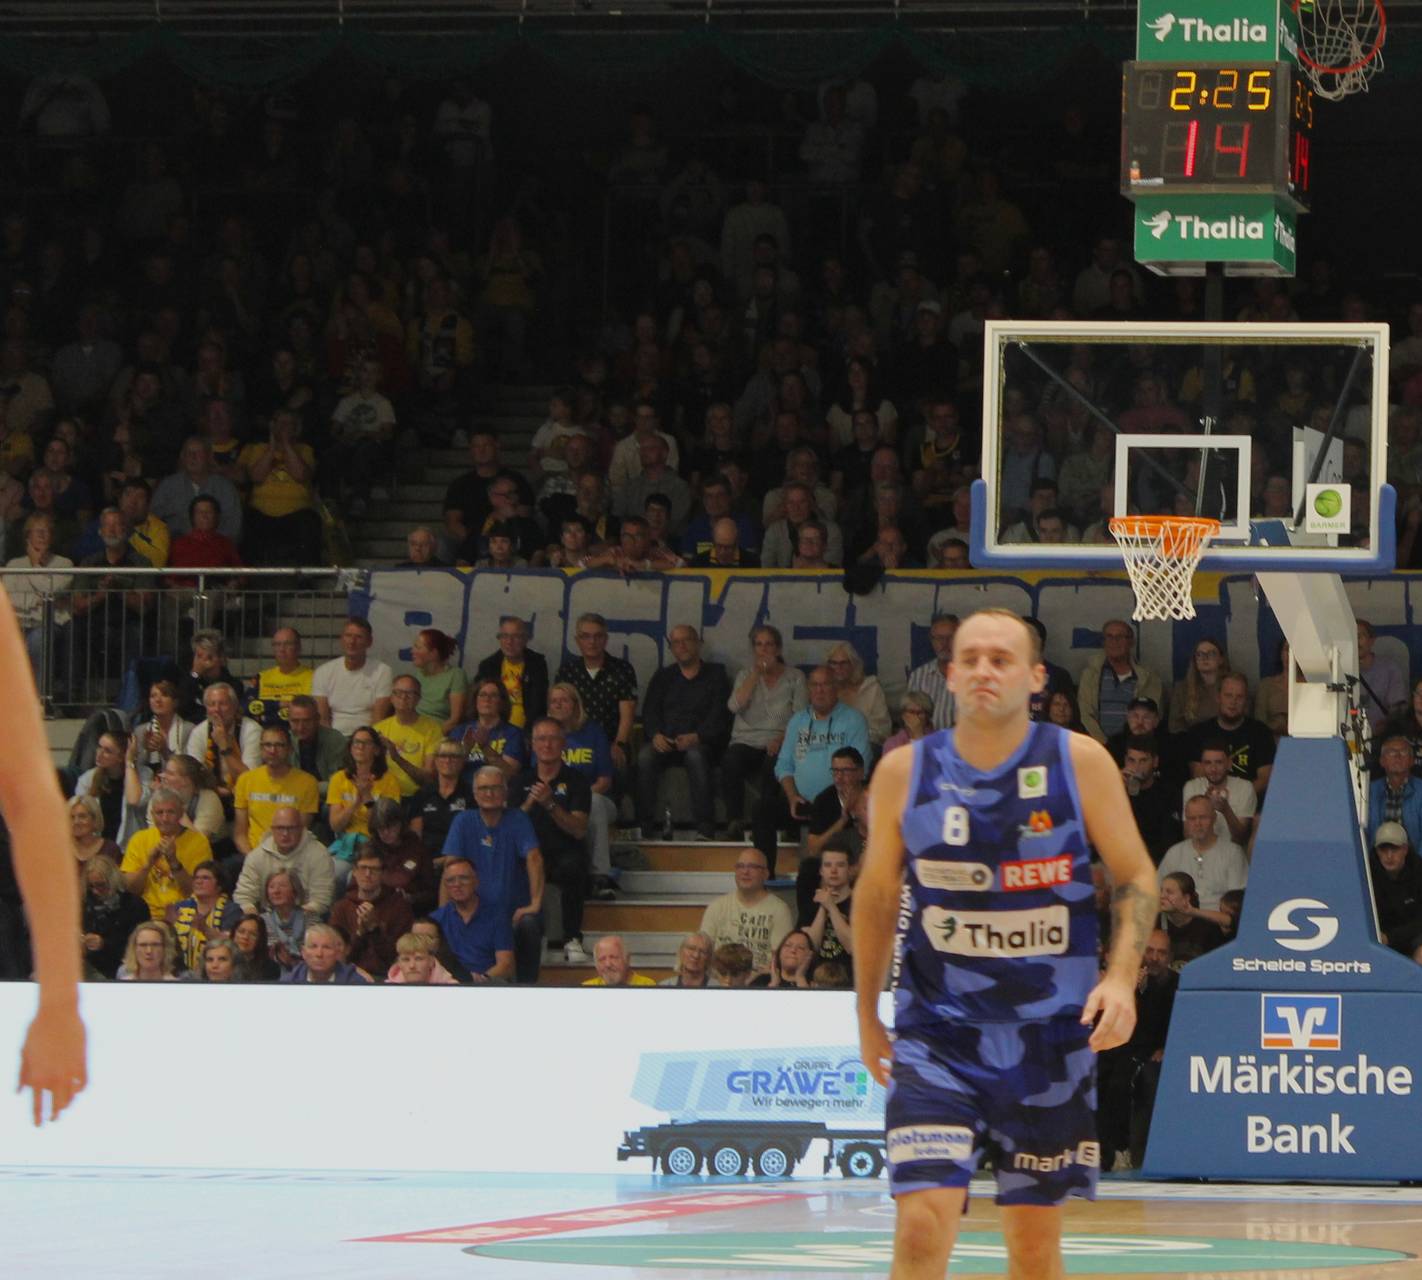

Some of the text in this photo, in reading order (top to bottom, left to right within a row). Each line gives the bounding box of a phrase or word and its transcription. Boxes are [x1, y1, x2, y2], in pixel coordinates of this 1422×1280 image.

[1179, 18, 1267, 42] Thalia
[1170, 70, 1271, 110] 2:25
[1184, 120, 1250, 177] 14
[1175, 215, 1264, 240] Thalia
[561, 747, 593, 764] AME
[942, 805, 970, 847] 8
[1003, 860, 1070, 888] REWE
[964, 919, 1064, 951] Thalia
[1310, 959, 1371, 975] Sports
[726, 1067, 841, 1096] GRÄWE
[1189, 1053, 1413, 1096] Märkische
[752, 1096, 773, 1108] Wir
[775, 1096, 830, 1109] bewegen
[1247, 1113, 1356, 1154] Bank
